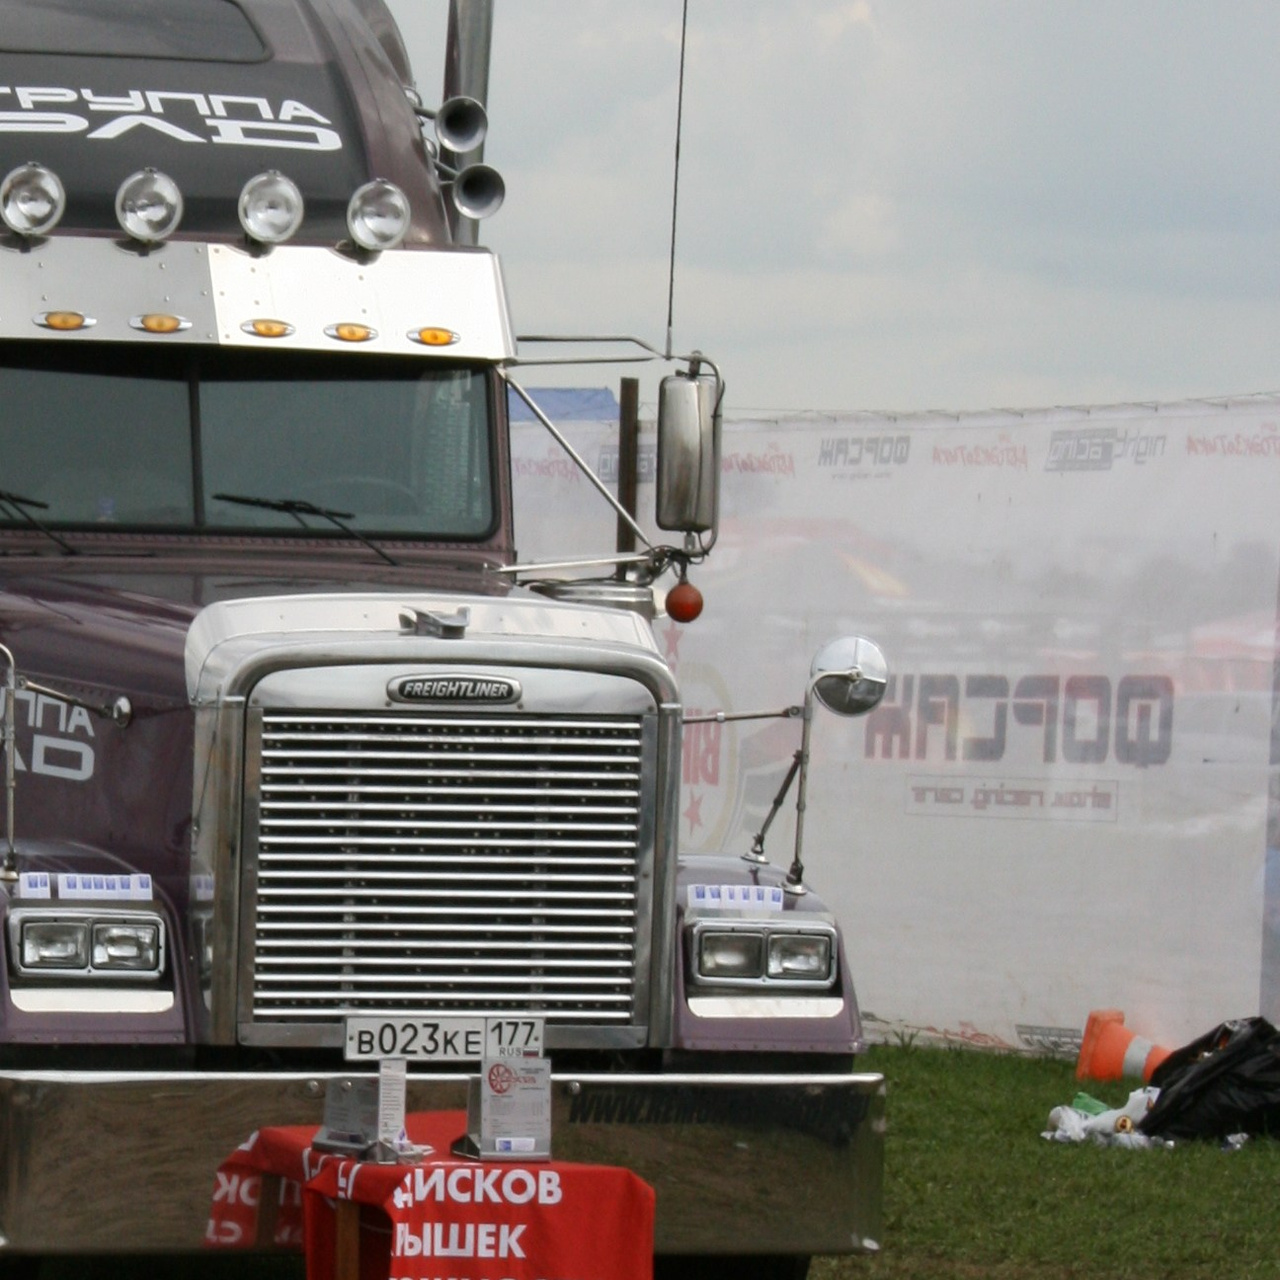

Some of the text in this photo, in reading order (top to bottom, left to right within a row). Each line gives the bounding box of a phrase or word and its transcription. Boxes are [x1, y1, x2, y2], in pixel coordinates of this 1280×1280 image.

[403, 681, 508, 699] FREIGHTLINER
[491, 1021, 535, 1046] 177
[499, 1047, 523, 1057] RUS
